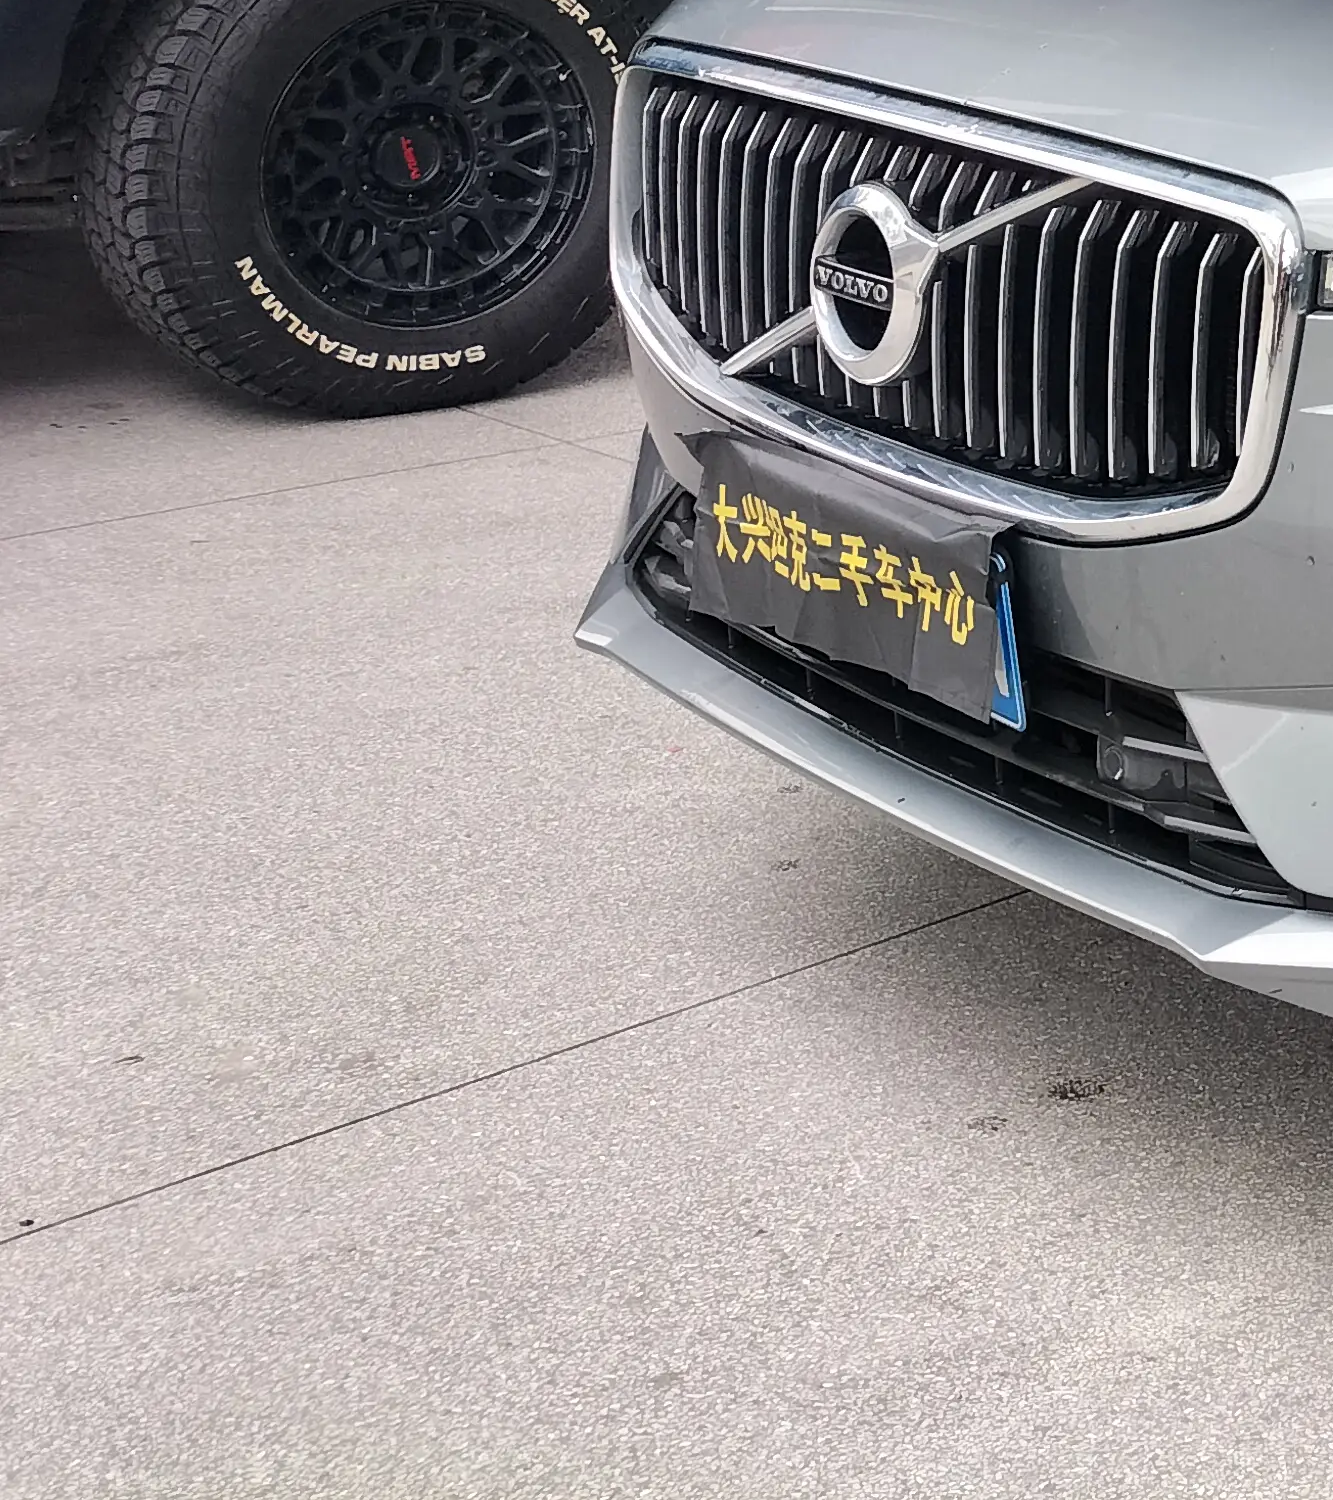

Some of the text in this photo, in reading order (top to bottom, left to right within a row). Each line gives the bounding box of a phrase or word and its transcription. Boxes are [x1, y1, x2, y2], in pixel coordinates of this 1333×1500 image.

[234, 255, 487, 372] SABIN PEARLMAN
[816, 264, 888, 303] VOLVO
[713, 483, 975, 646] 大兴坦克二手车中心
